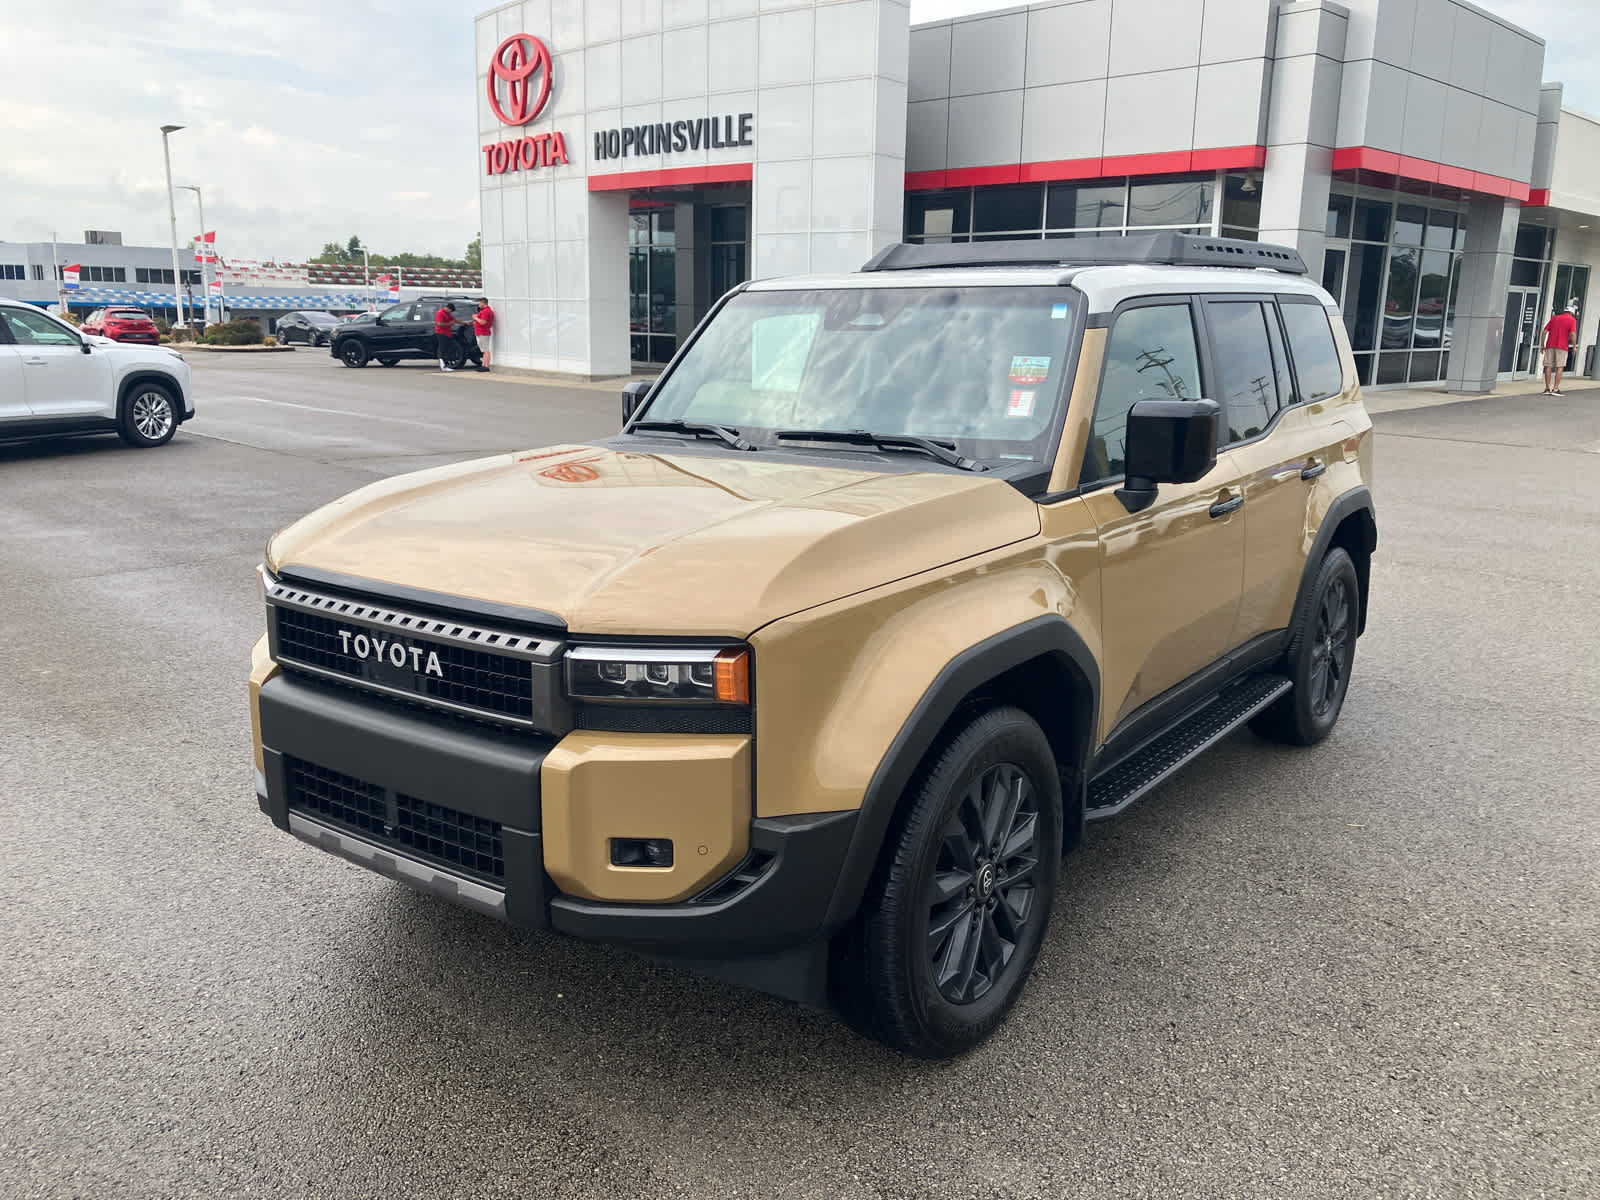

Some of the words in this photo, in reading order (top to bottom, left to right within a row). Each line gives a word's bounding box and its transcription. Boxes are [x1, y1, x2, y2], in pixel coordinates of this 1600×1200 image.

[482, 131, 569, 176] TOYOTA
[594, 113, 753, 161] HOPKINSVILLE
[338, 629, 443, 677] TOYOTA
